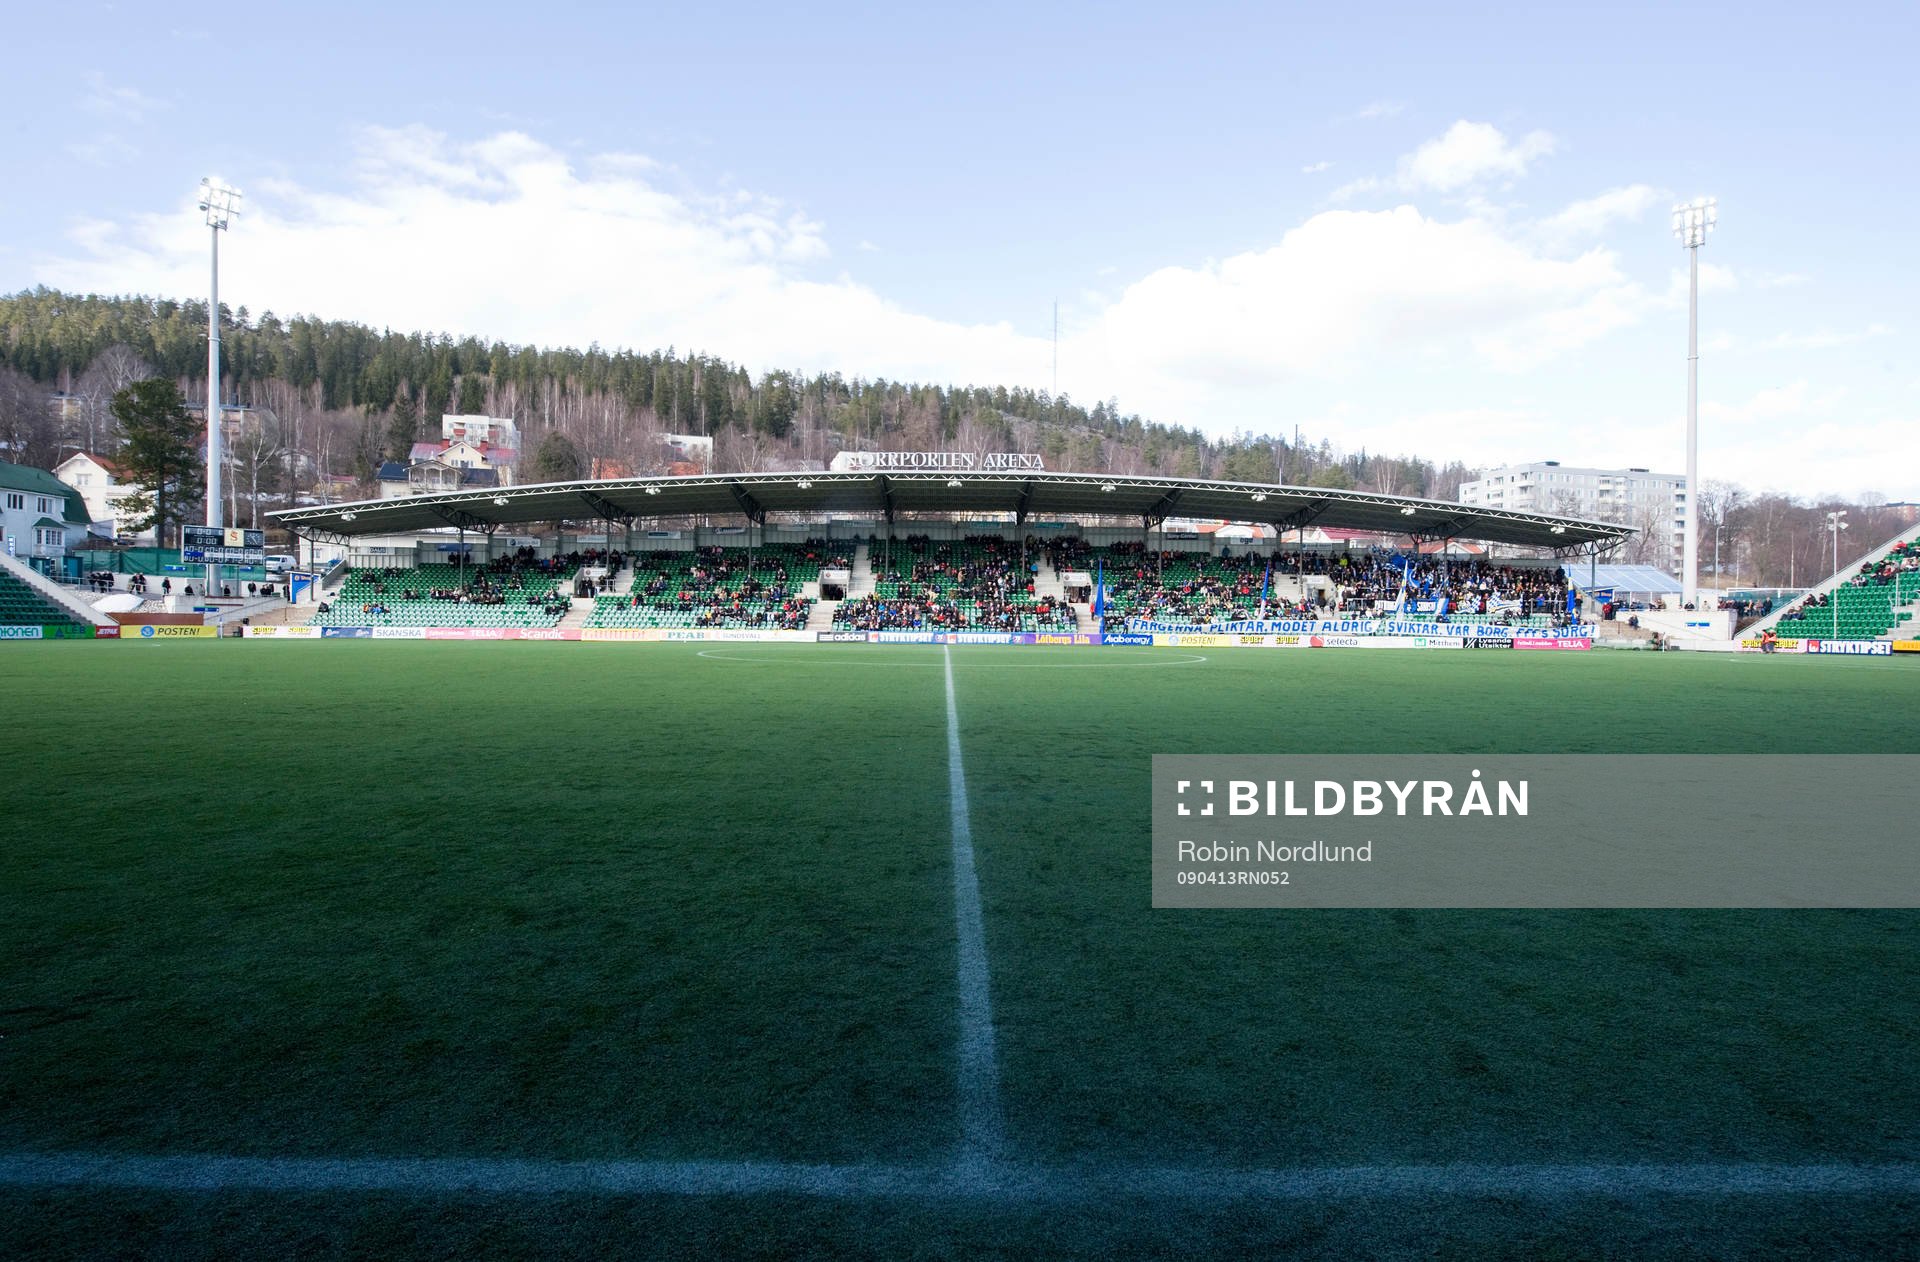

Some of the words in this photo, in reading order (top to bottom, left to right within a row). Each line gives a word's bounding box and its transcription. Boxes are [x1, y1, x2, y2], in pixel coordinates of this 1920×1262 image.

[983, 453, 1045, 468] ARENA
[157, 627, 200, 636] POSTEN!
[1271, 621, 1316, 632] MODET
[1321, 621, 1374, 633] ALDRIG
[376, 628, 421, 637] SKANSKA
[520, 628, 565, 639] Scandic
[667, 631, 705, 639] PEAB
[833, 632, 866, 642] adidas
[1181, 636, 1216, 645] POSTEN!
[1326, 636, 1358, 646] selecta
[1557, 640, 1584, 648] TELIA
[1820, 641, 1892, 654] STRYKTIPSET
